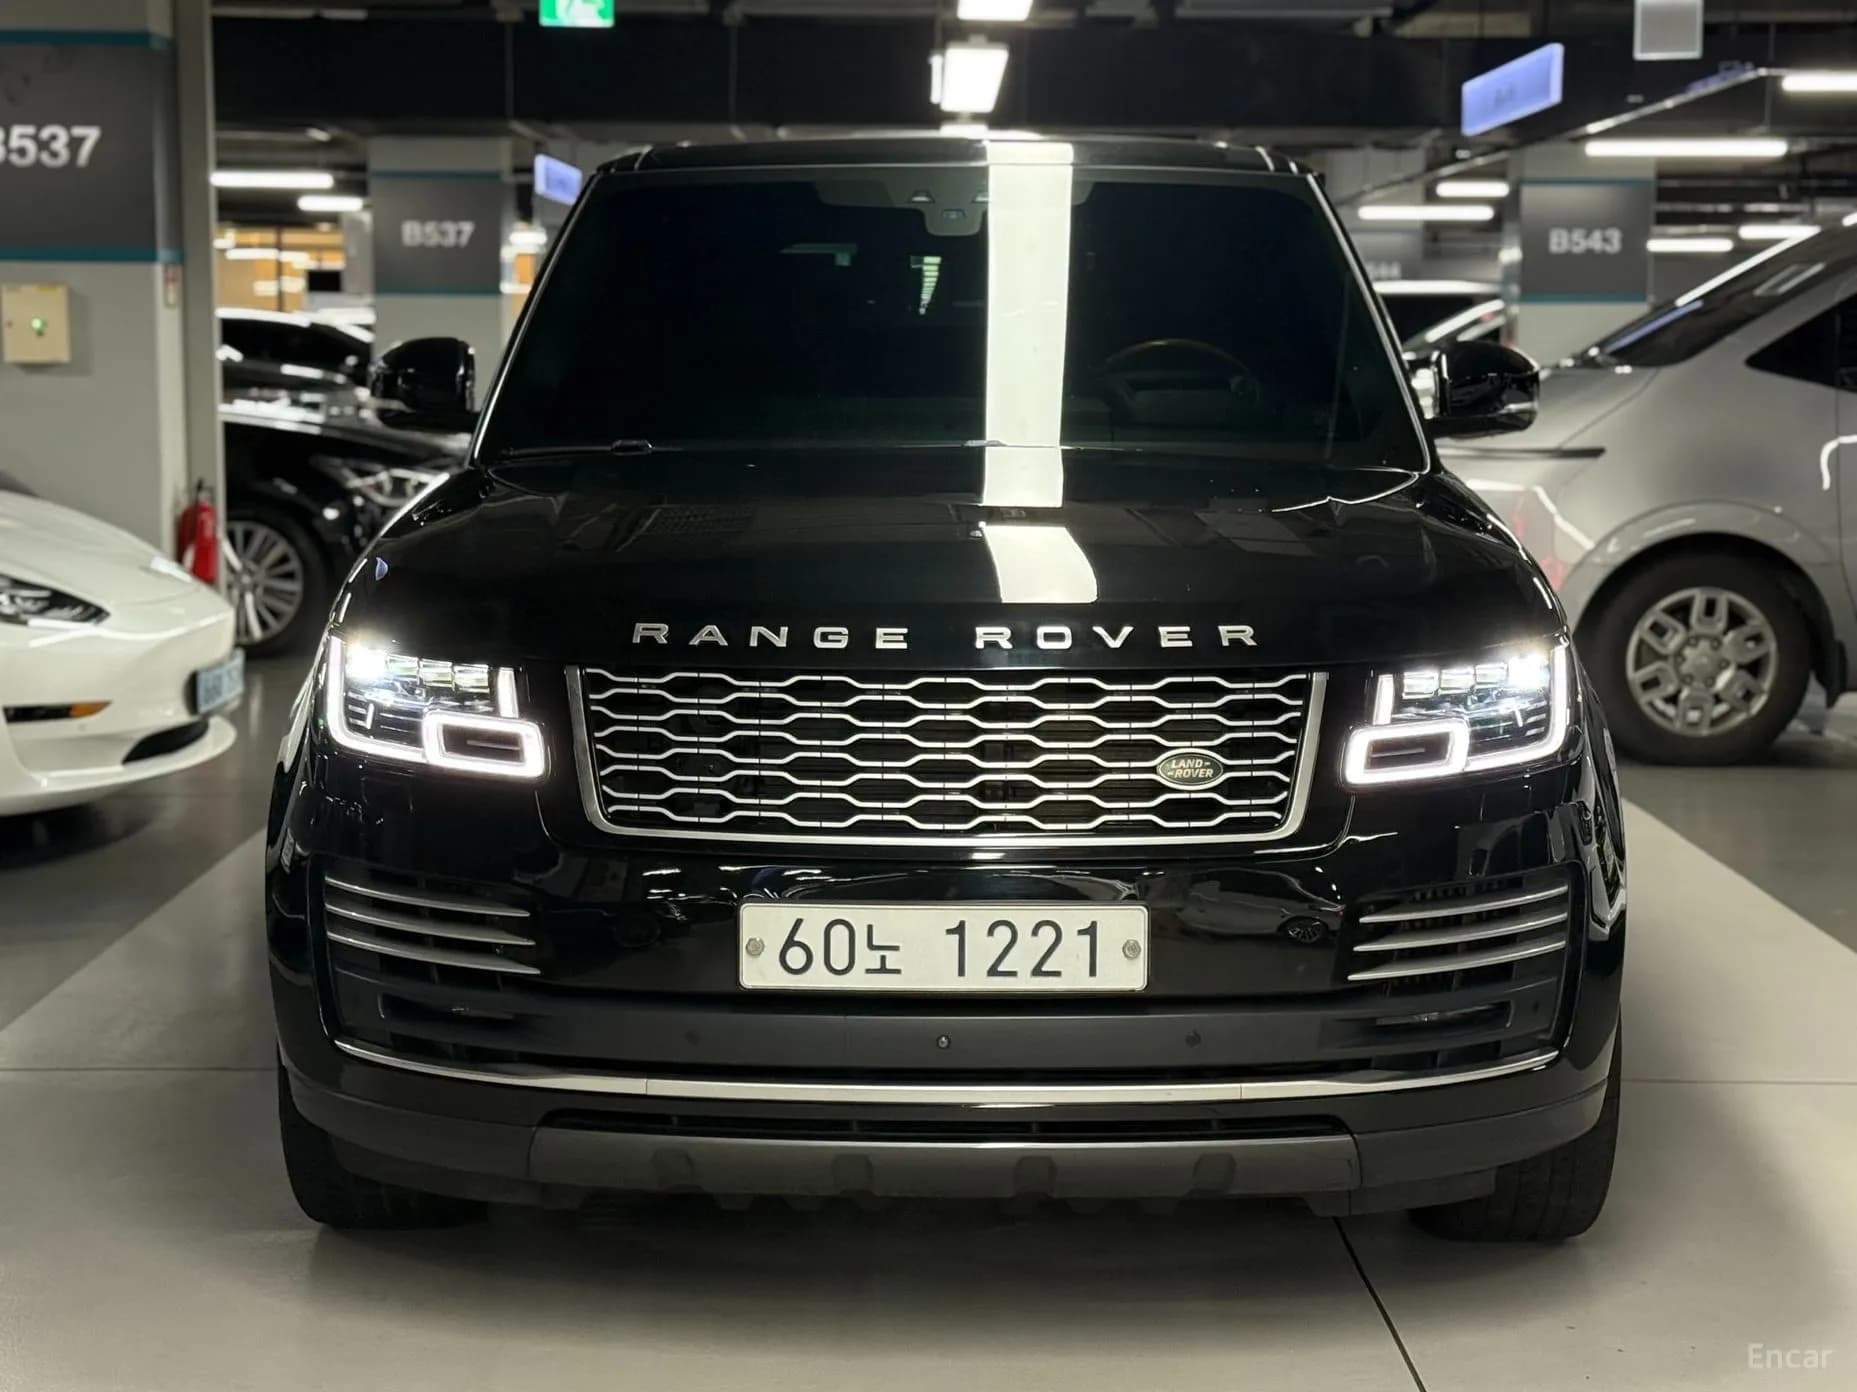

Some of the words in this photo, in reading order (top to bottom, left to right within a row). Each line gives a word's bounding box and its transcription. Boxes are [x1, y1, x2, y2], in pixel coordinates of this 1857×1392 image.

[0, 124, 101, 168] 537
[401, 220, 475, 248] B537
[1549, 227, 1622, 254] B543
[632, 622, 908, 649] RANGE
[975, 625, 1258, 650] ROVER
[778, 918, 901, 975] 60노
[945, 919, 1100, 977] 1221
